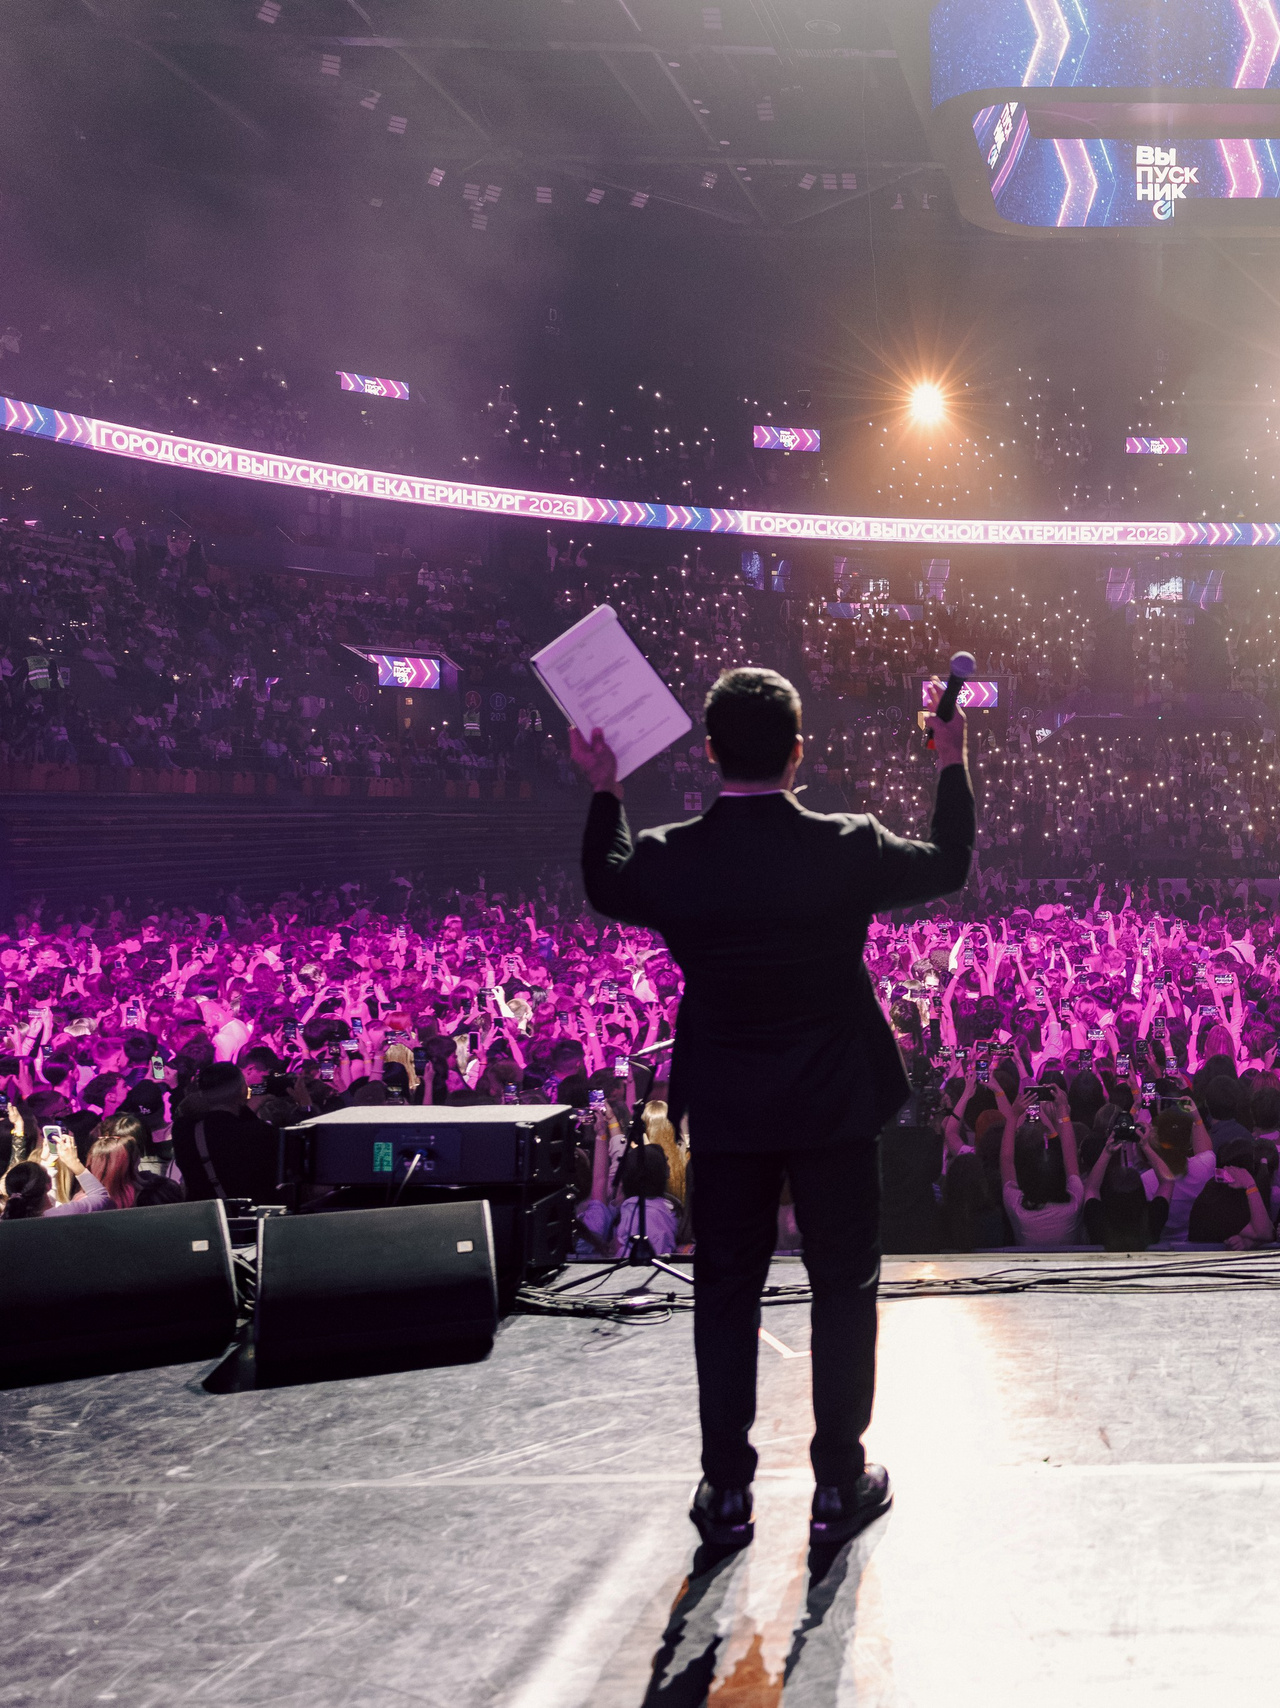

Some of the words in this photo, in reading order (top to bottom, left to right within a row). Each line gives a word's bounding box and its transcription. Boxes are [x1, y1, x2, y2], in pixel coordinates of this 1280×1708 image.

[1136, 145, 1176, 166] ВЫ
[1136, 166, 1199, 183] ПУСК
[1136, 183, 1187, 200] НИК
[101, 428, 232, 470] ГОРОДСКОЙ
[237, 454, 368, 491] ВЫПУСКНОЙ
[373, 477, 525, 511] ЕКАТЕРИНБУРГ
[528, 497, 575, 516] 2026
[751, 516, 866, 537] ГОРОДСКОЙ
[870, 521, 984, 541] ВЫПУСКНОЙ
[989, 525, 1124, 542] ЕКАТЕРИНБУРГ
[1127, 527, 1169, 542] 2026
